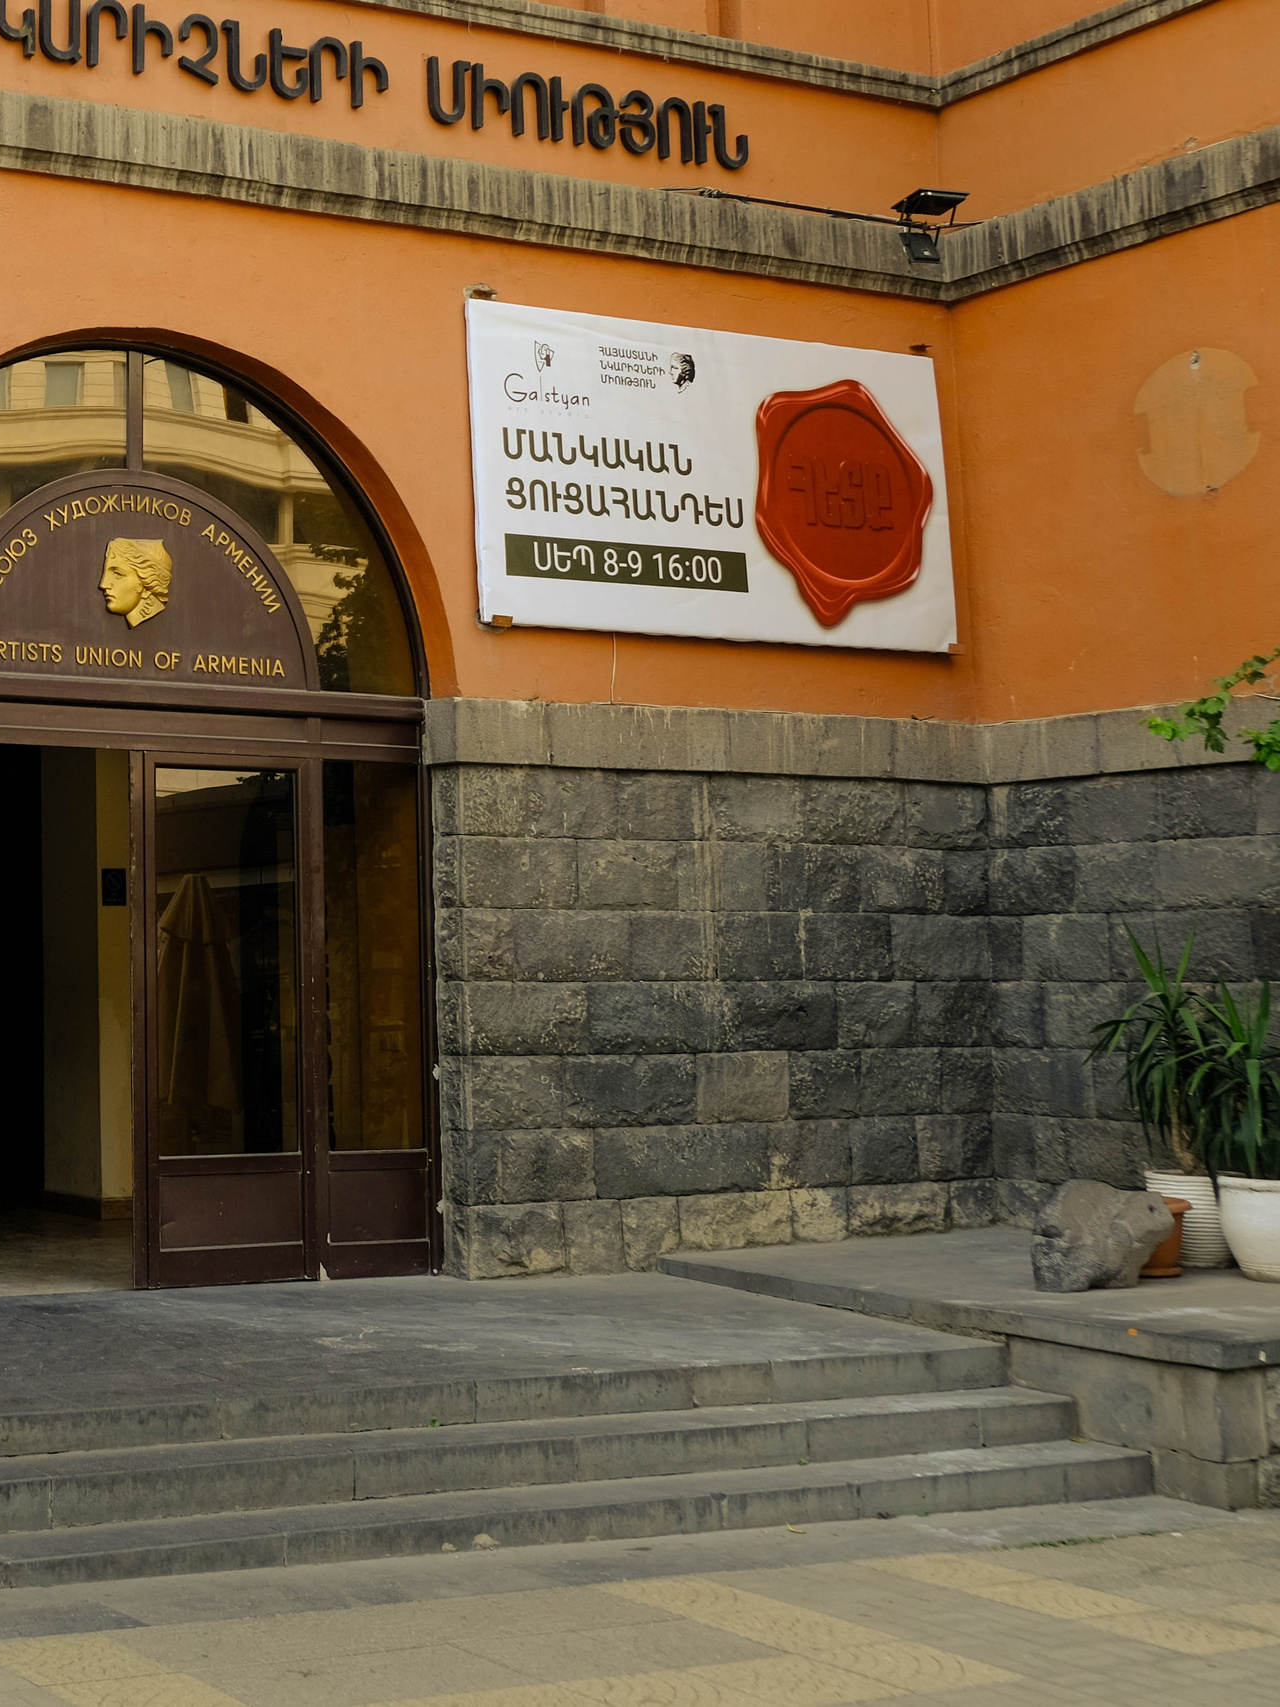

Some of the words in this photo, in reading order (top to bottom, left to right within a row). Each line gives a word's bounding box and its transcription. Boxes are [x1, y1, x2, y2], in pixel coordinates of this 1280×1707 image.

[426, 55, 750, 171] ՄԻՈՒԹՅՈՒՆ
[598, 346, 659, 362] ՀԱՅԱՍՏԱՆԻ
[599, 360, 666, 377] ՆԿԱՐԻՉՆԵՐԻ
[504, 372, 591, 410] Galstyan
[600, 374, 657, 389] ՄԻՈՒԹՅՈՒՆ
[502, 426, 693, 476] ՄԱՆԿԱԿԱՆ
[505, 476, 744, 529] ՑՈՒՑԱՀԱՆԴԵՍ
[43, 494, 193, 532] ХУДОЖНИКОВ
[200, 523, 282, 615] АРМЕНИИ
[533, 541, 596, 575] ՍԵՊ
[603, 549, 643, 578] 8-9
[653, 553, 723, 584] 16:00
[75, 646, 143, 669] UNION
[153, 651, 182, 671] OF
[193, 654, 286, 678] ARMENIA
